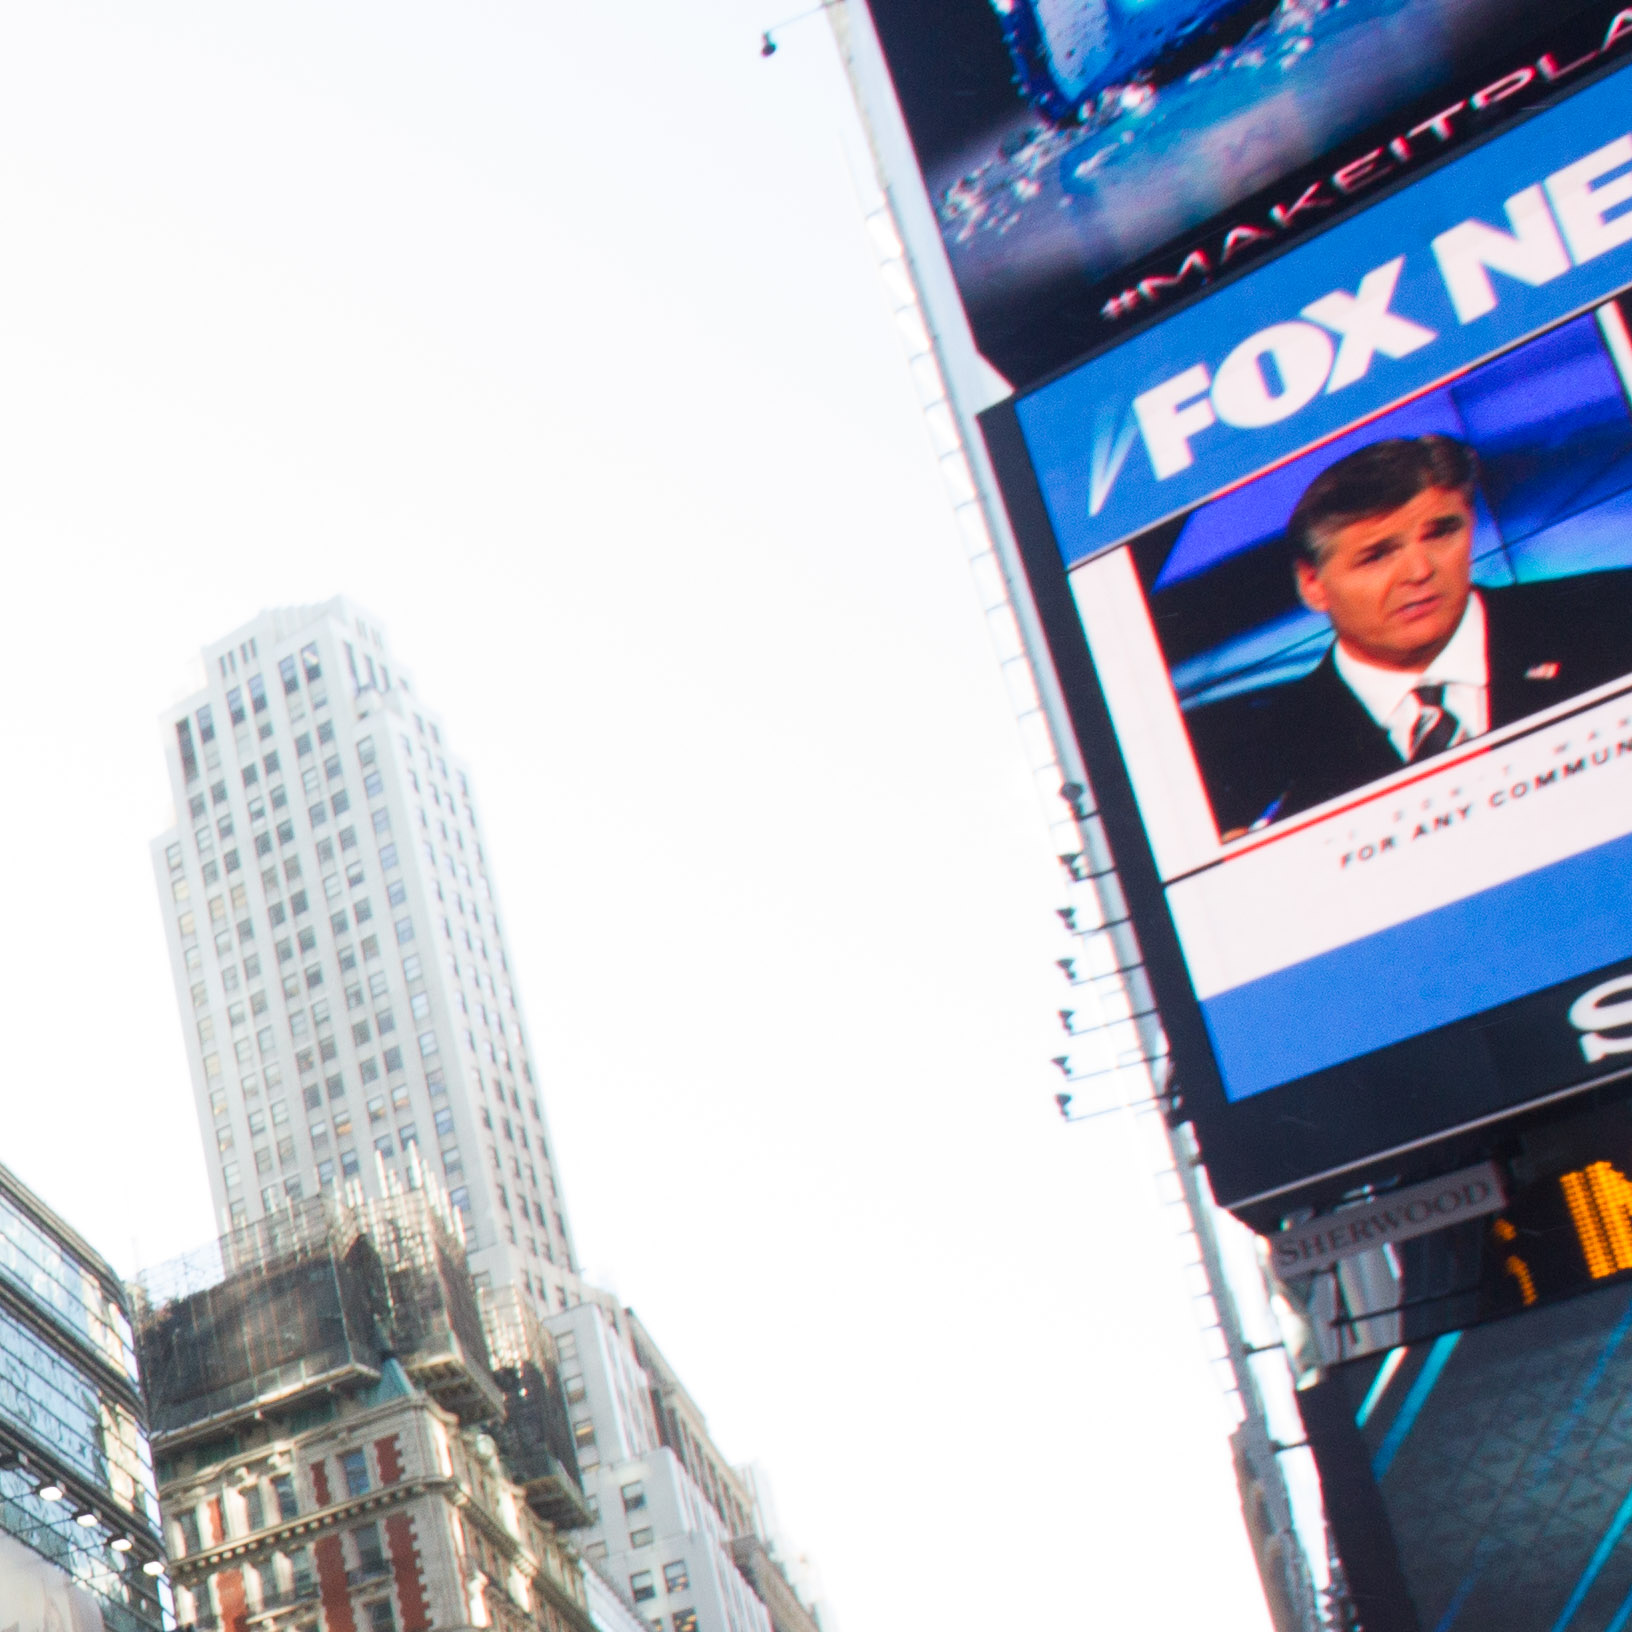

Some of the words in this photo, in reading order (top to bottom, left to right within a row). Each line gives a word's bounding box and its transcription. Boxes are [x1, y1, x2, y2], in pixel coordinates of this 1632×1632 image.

[1133, 255, 1437, 481] FOX
[1340, 836, 1397, 869] FOR
[1412, 803, 1472, 841] ANY
[1277, 1180, 1492, 1267] SHERWOOD
